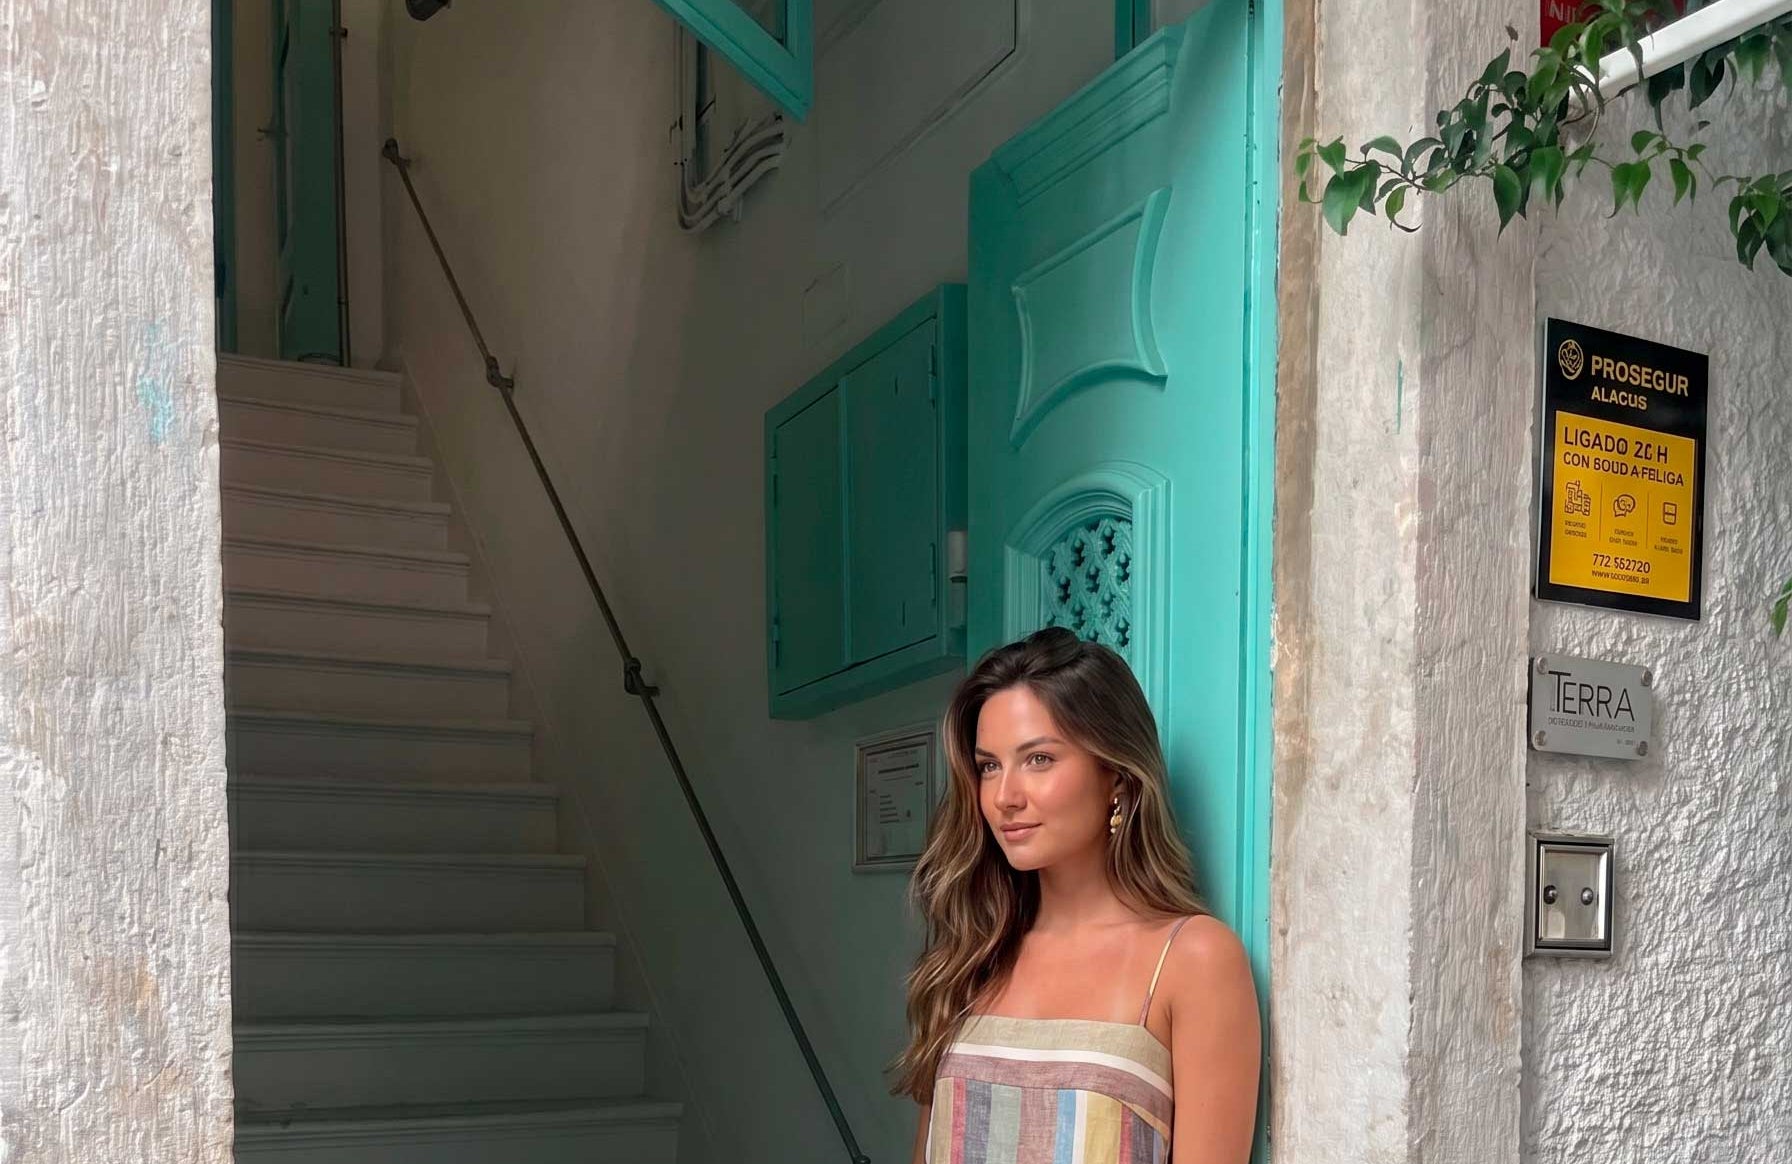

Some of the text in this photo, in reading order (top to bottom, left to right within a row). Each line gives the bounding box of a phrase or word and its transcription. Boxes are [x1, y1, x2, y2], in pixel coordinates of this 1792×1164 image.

[1591, 355, 1689, 397] PROSEGUR
[1591, 386, 1648, 411] ALACUS
[1563, 451, 1590, 469] CON
[1564, 426, 1628, 456] LIGADO
[1657, 444, 1669, 465] H
[1593, 553, 1611, 568] 772
[1548, 670, 1635, 722] TERRA
